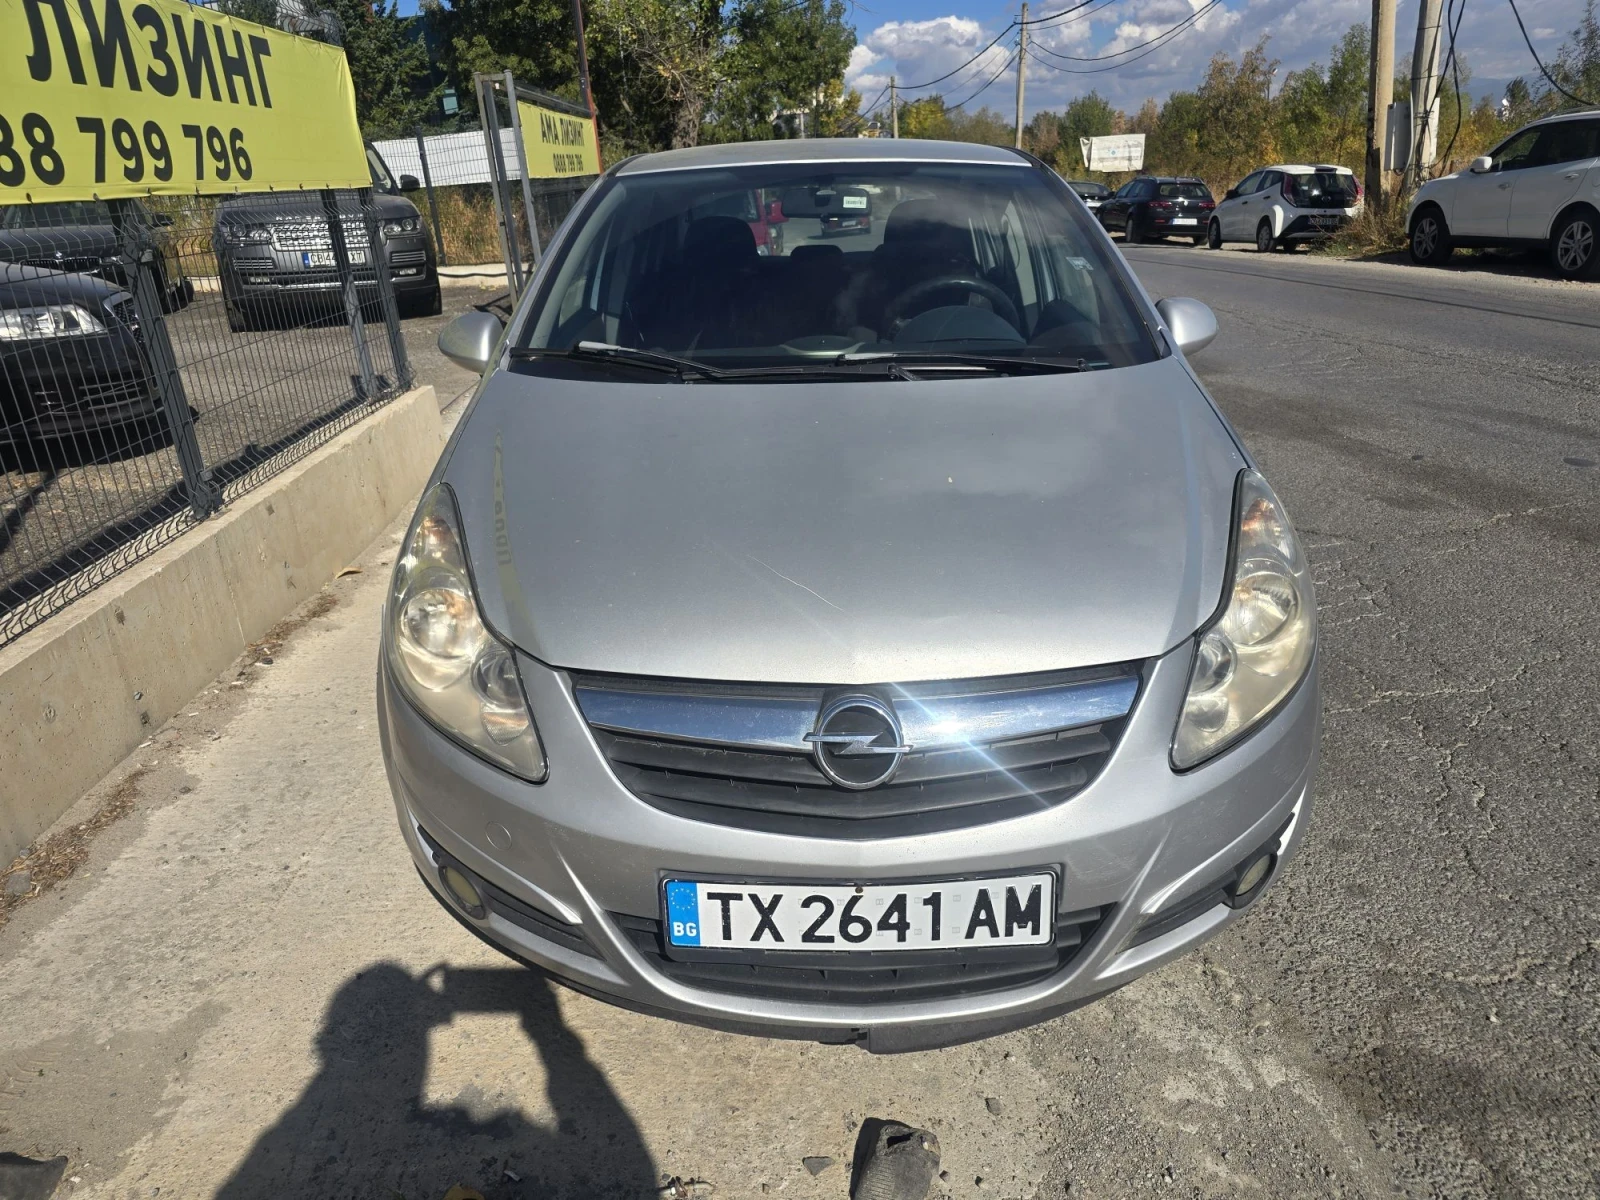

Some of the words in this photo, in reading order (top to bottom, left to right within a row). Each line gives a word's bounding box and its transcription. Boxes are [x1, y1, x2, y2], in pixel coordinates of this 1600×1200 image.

[23, 0, 272, 109] ЛИЗИНГ
[75, 116, 173, 183] 799
[181, 123, 252, 182] 796
[673, 921, 697, 937] BG
[707, 891, 785, 943] TX
[800, 889, 942, 944] 2641
[964, 884, 1042, 939] AM
